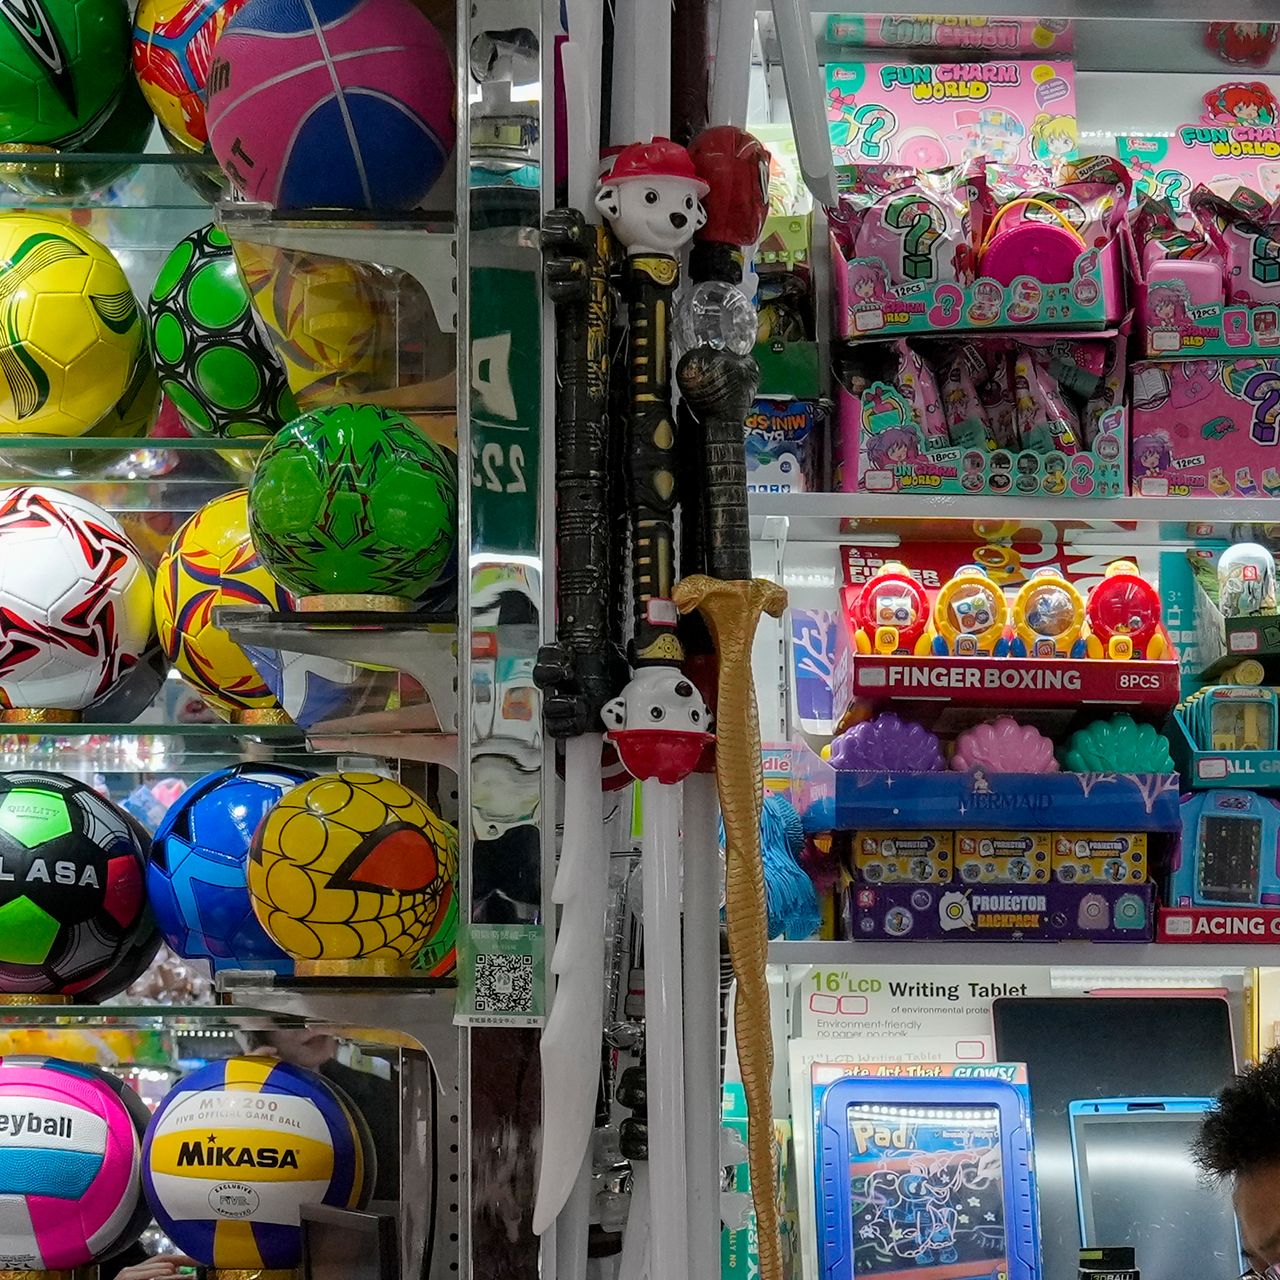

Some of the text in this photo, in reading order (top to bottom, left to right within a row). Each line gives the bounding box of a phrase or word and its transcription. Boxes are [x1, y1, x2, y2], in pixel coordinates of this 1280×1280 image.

[881, 64, 932, 88] FUN
[936, 64, 1018, 83] CHARM
[913, 82, 987, 100] WORLD
[1181, 128, 1229, 145] FUN
[1213, 142, 1280, 156] WORLD
[894, 284, 922, 297] 12PCS
[1191, 308, 1217, 319] 12PCS
[931, 452, 957, 464] 18PCS
[1175, 456, 1201, 469] 12PCS
[888, 667, 1160, 690] FINGER BOXING 8PCS
[972, 895, 1046, 911] PROJECTOR
[977, 914, 1040, 928] BACKPACK
[888, 982, 1028, 1000] Writing Tablet
[891, 1006, 965, 1014] of environmental
[816, 1018, 922, 1030] Environment-friendly
[875, 1066, 1015, 1081] Art That GLOWS!
[245, 1111, 274, 1122] GAME
[278, 1116, 301, 1129] BALL
[214, 1183, 252, 1194] EXCLUSIVE
